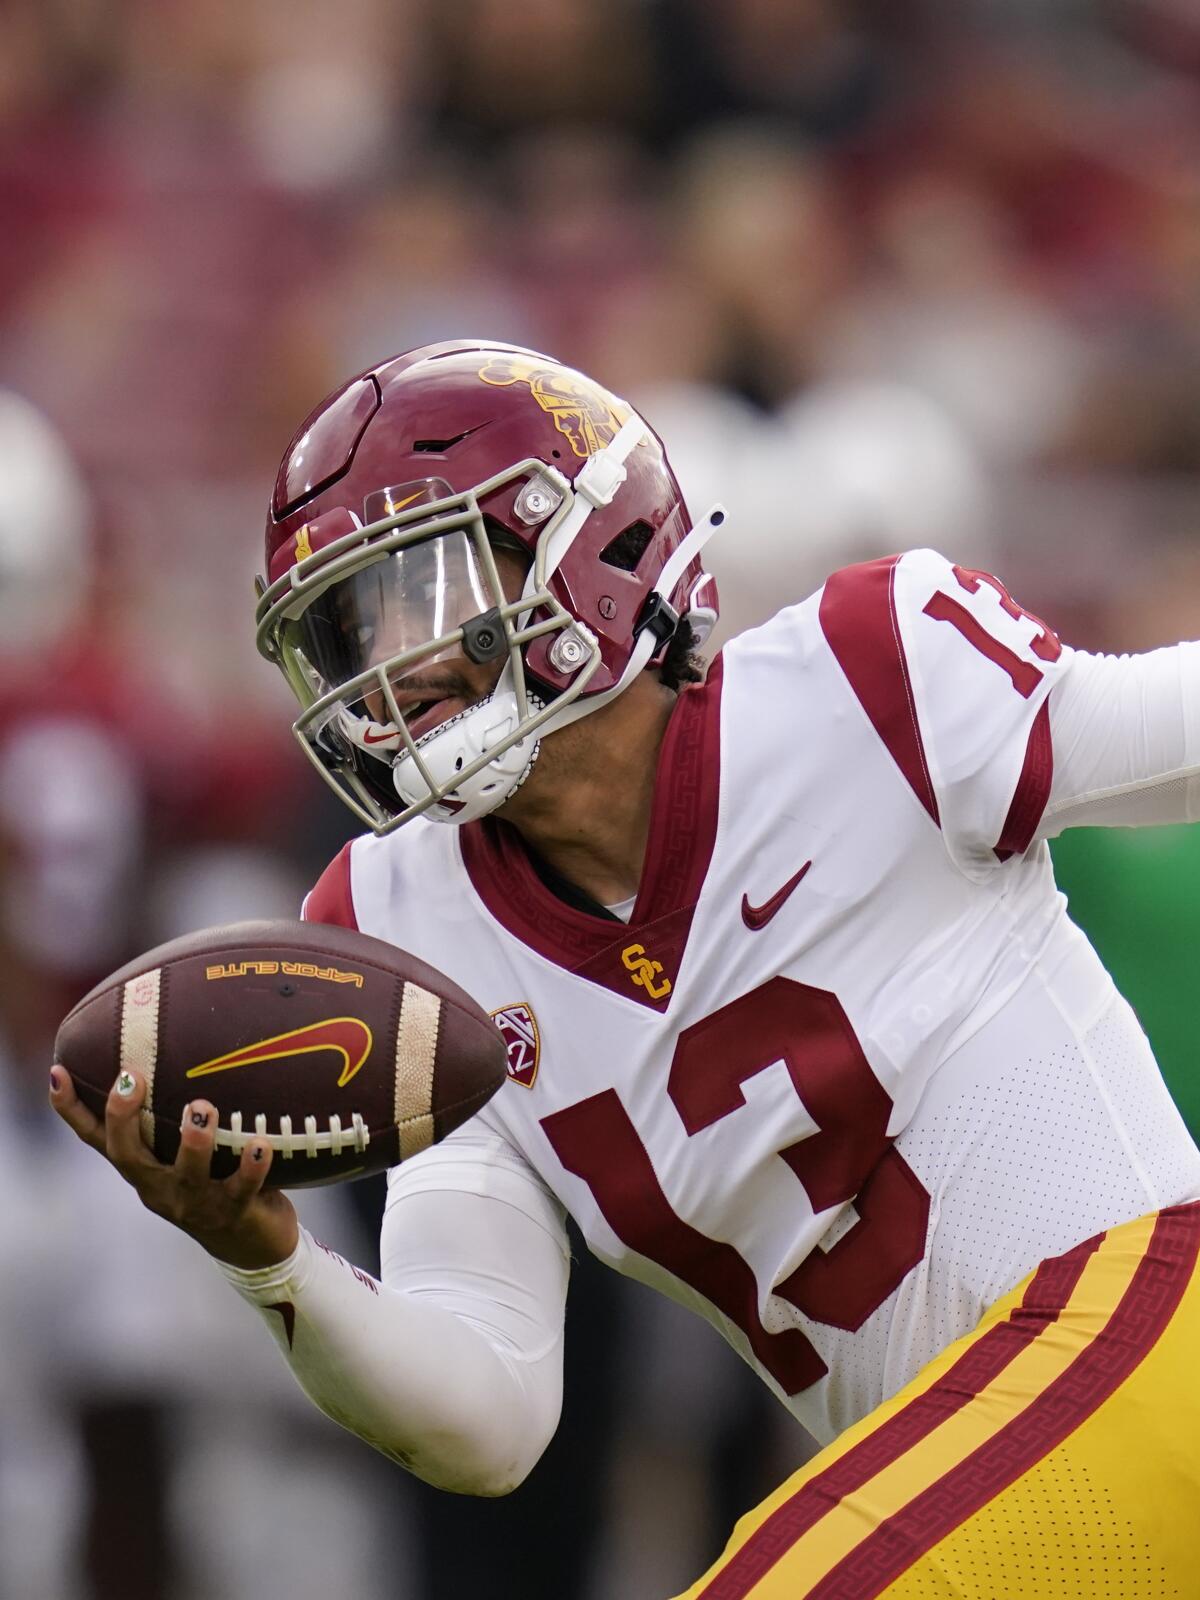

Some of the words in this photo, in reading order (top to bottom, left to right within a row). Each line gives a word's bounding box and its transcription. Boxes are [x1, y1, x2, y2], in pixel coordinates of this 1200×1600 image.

[922, 565, 1063, 700] 13
[206, 961, 279, 981] ELITE
[281, 961, 365, 989] VAPOR
[621, 943, 672, 999] SC
[491, 1006, 535, 1049] AC
[539, 975, 932, 1397] 13
